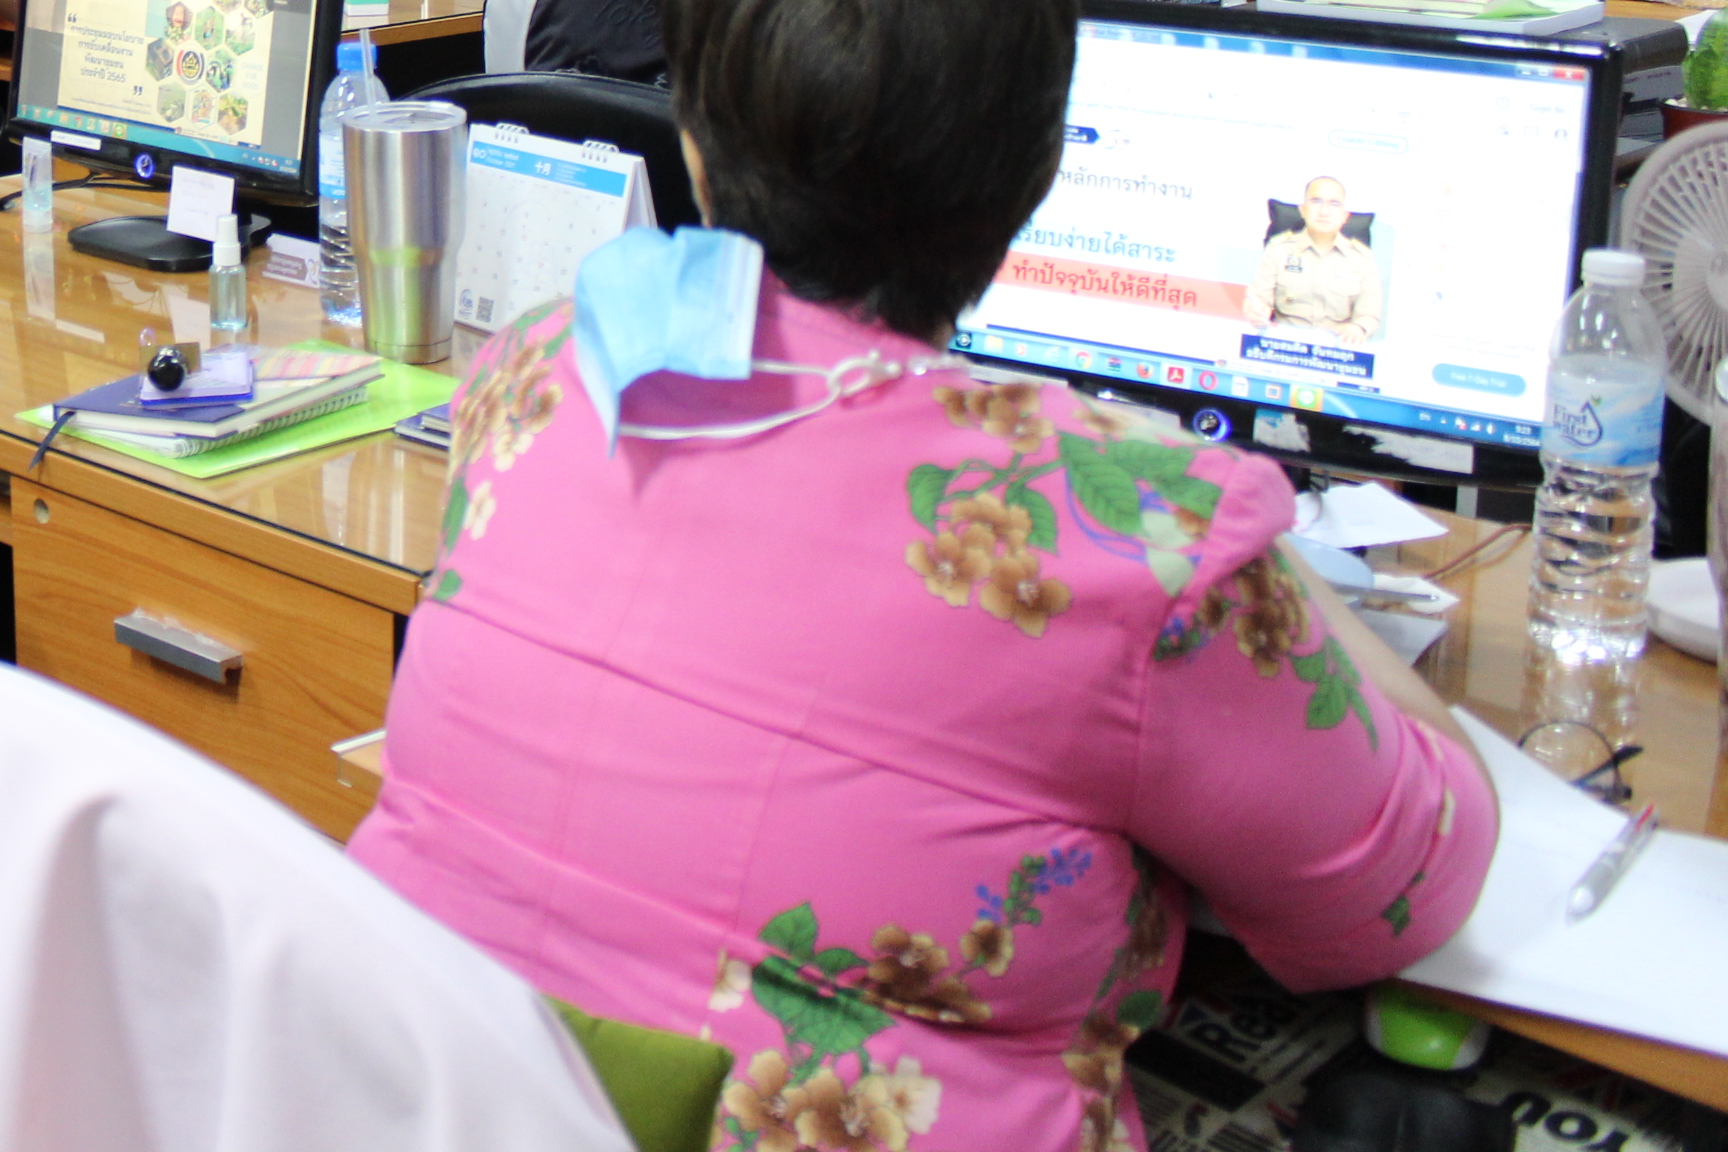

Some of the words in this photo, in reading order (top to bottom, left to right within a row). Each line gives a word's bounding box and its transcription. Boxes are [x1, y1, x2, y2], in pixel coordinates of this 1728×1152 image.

[1058, 165, 1193, 200] หลักการทำงาน
[1012, 259, 1198, 312] ทำปัจจุบันให้ดีที่สุด
[1552, 420, 1593, 439] water
[1553, 402, 1588, 427] First
